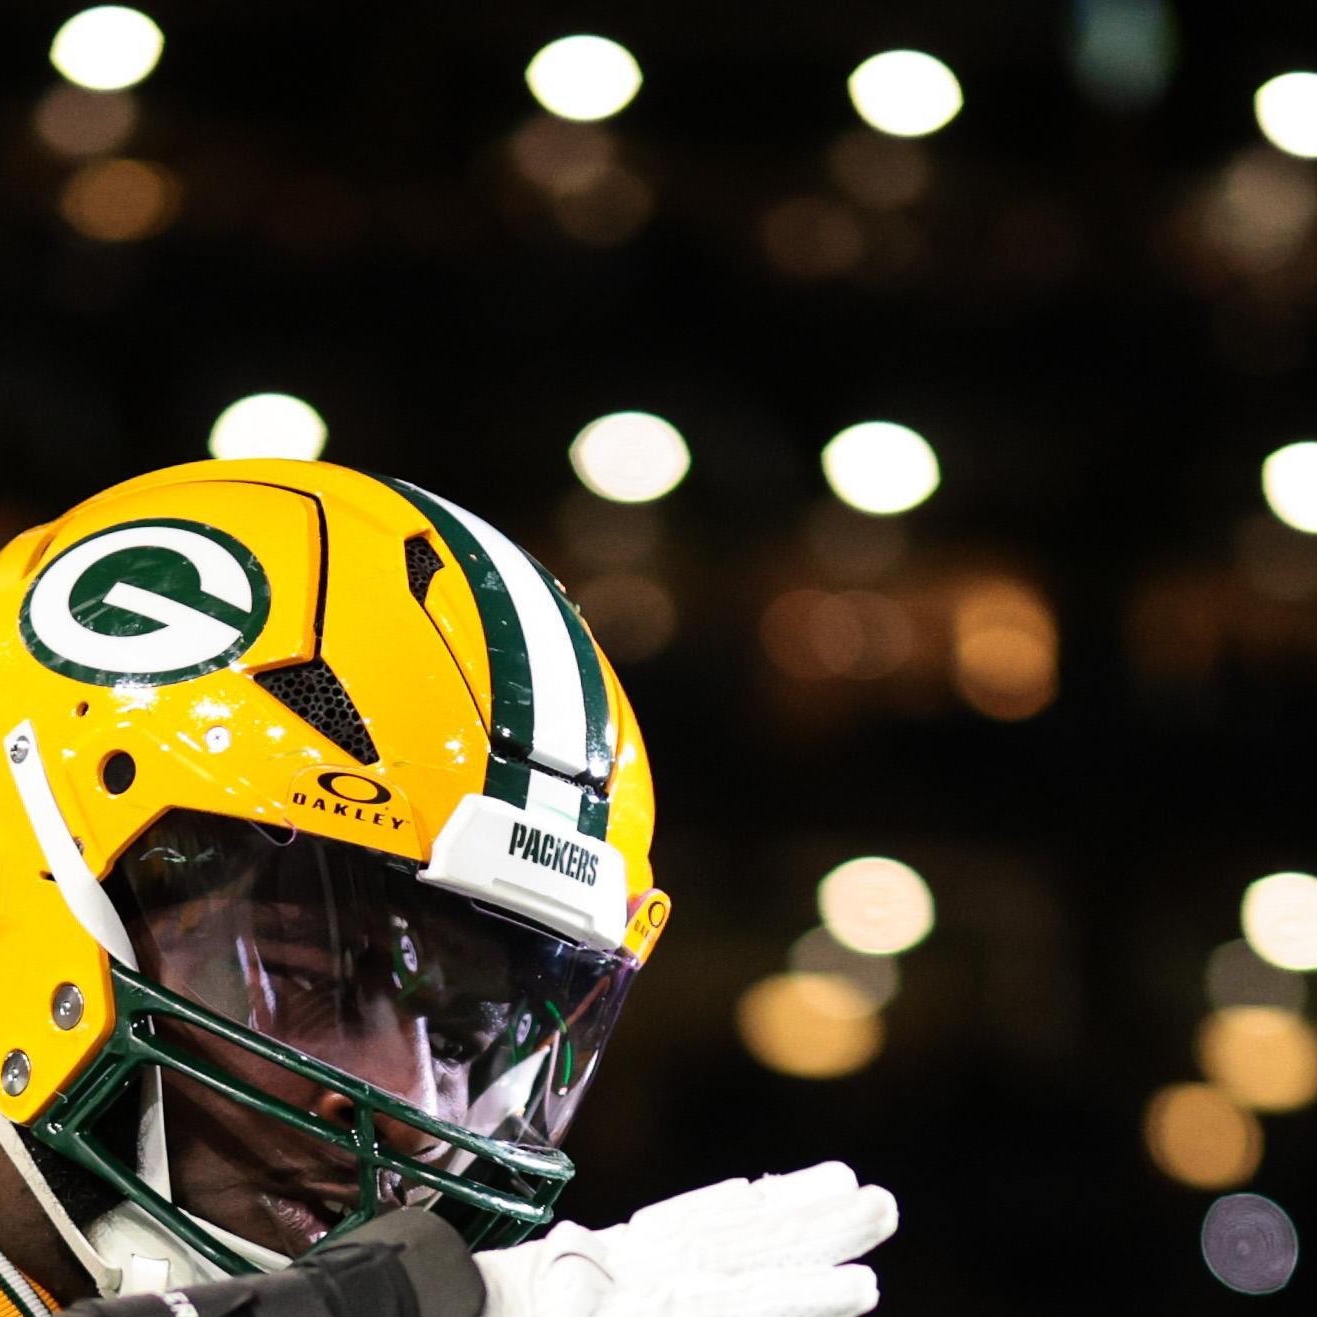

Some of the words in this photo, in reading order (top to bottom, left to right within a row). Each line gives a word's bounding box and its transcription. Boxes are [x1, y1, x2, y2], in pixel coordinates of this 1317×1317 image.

[30, 527, 252, 673] G
[292, 792, 405, 830] OAKLEY
[508, 822, 599, 887] PACKERS
